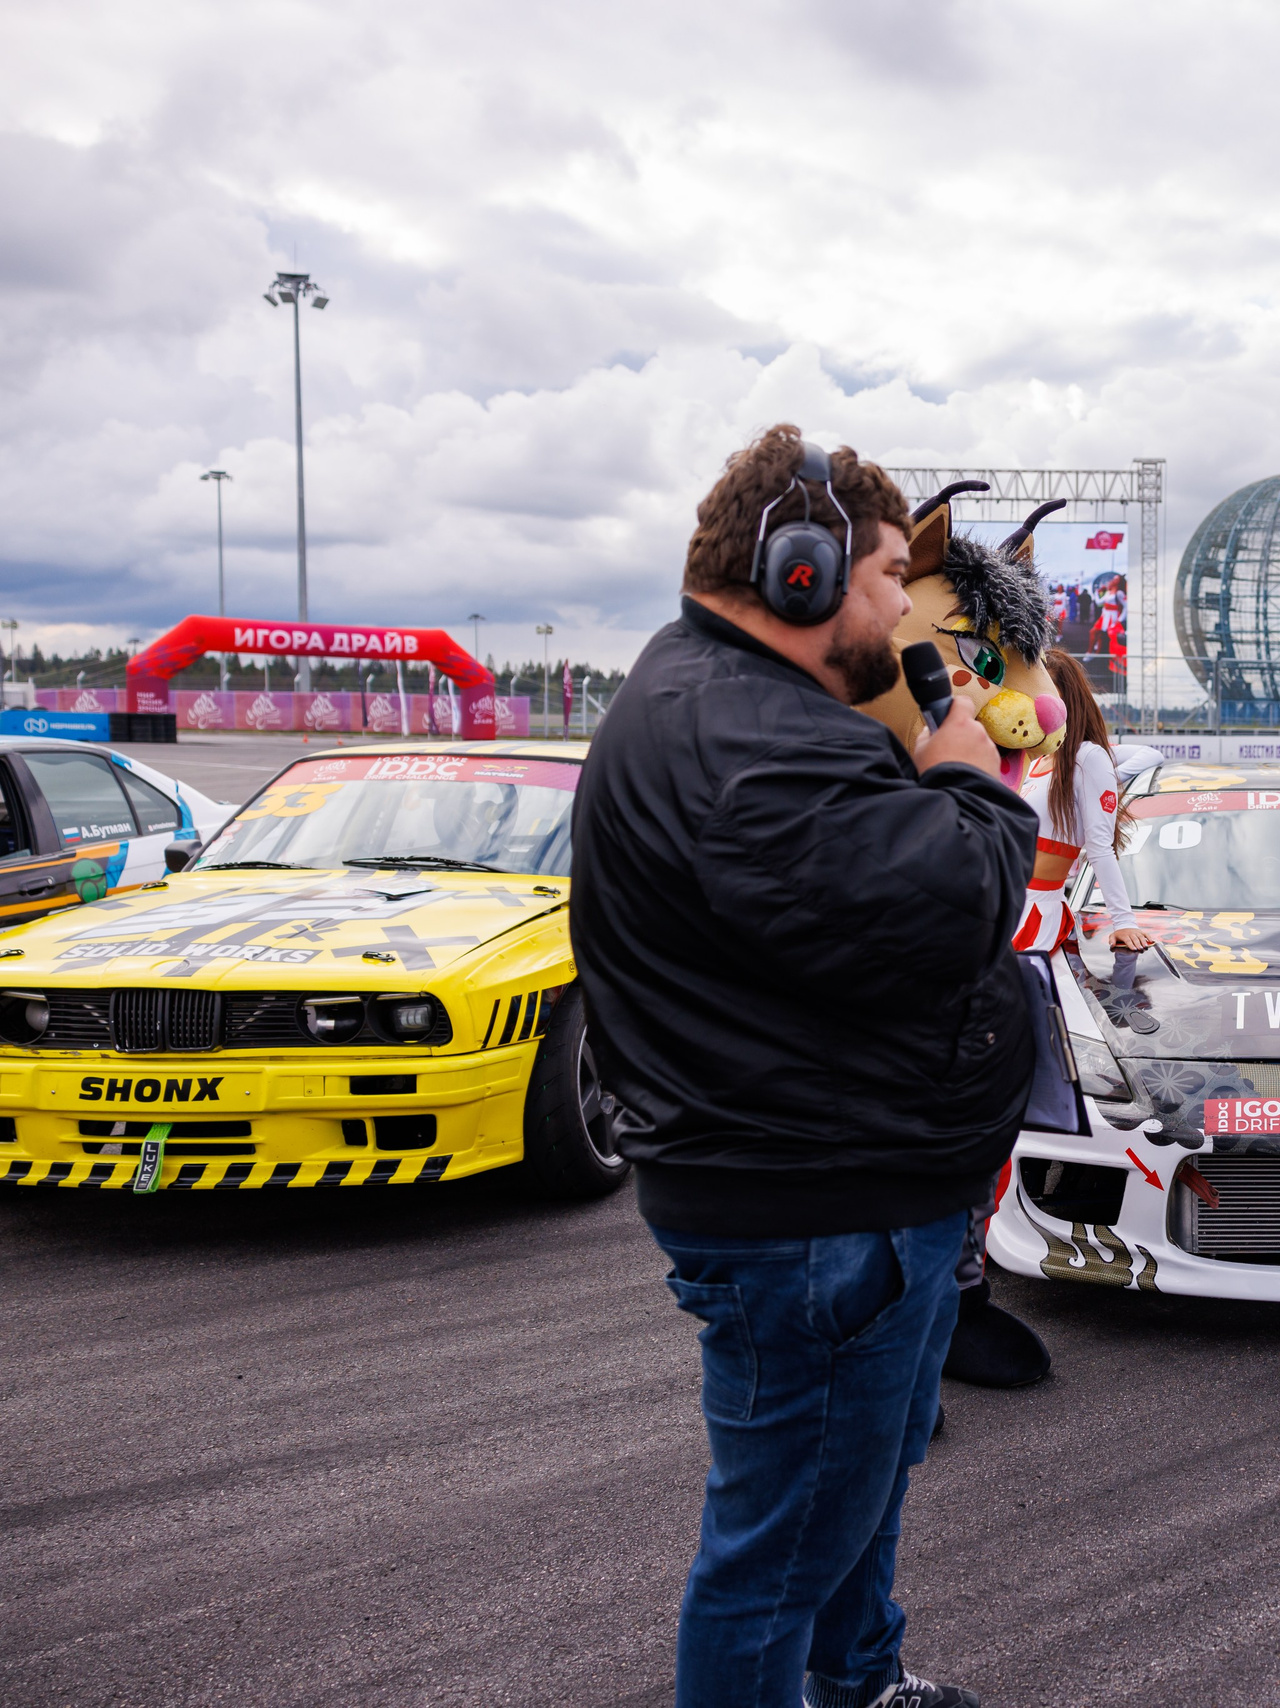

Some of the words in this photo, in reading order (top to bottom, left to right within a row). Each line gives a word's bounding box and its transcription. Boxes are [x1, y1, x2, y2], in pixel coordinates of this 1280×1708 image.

[787, 565, 814, 587] R
[234, 627, 322, 651] ИГОРА
[323, 631, 419, 654] ДРАЙВ
[363, 773, 394, 781] DRIFT
[395, 773, 456, 781] CHALLENGE
[366, 761, 464, 775] IDDC
[235, 784, 344, 821] 33
[80, 822, 132, 839] А.Бутман
[59, 943, 170, 960] SOLID
[179, 943, 315, 963] WORKS
[79, 1076, 224, 1102] SHONX
[1218, 1102, 1229, 1132] IDDC
